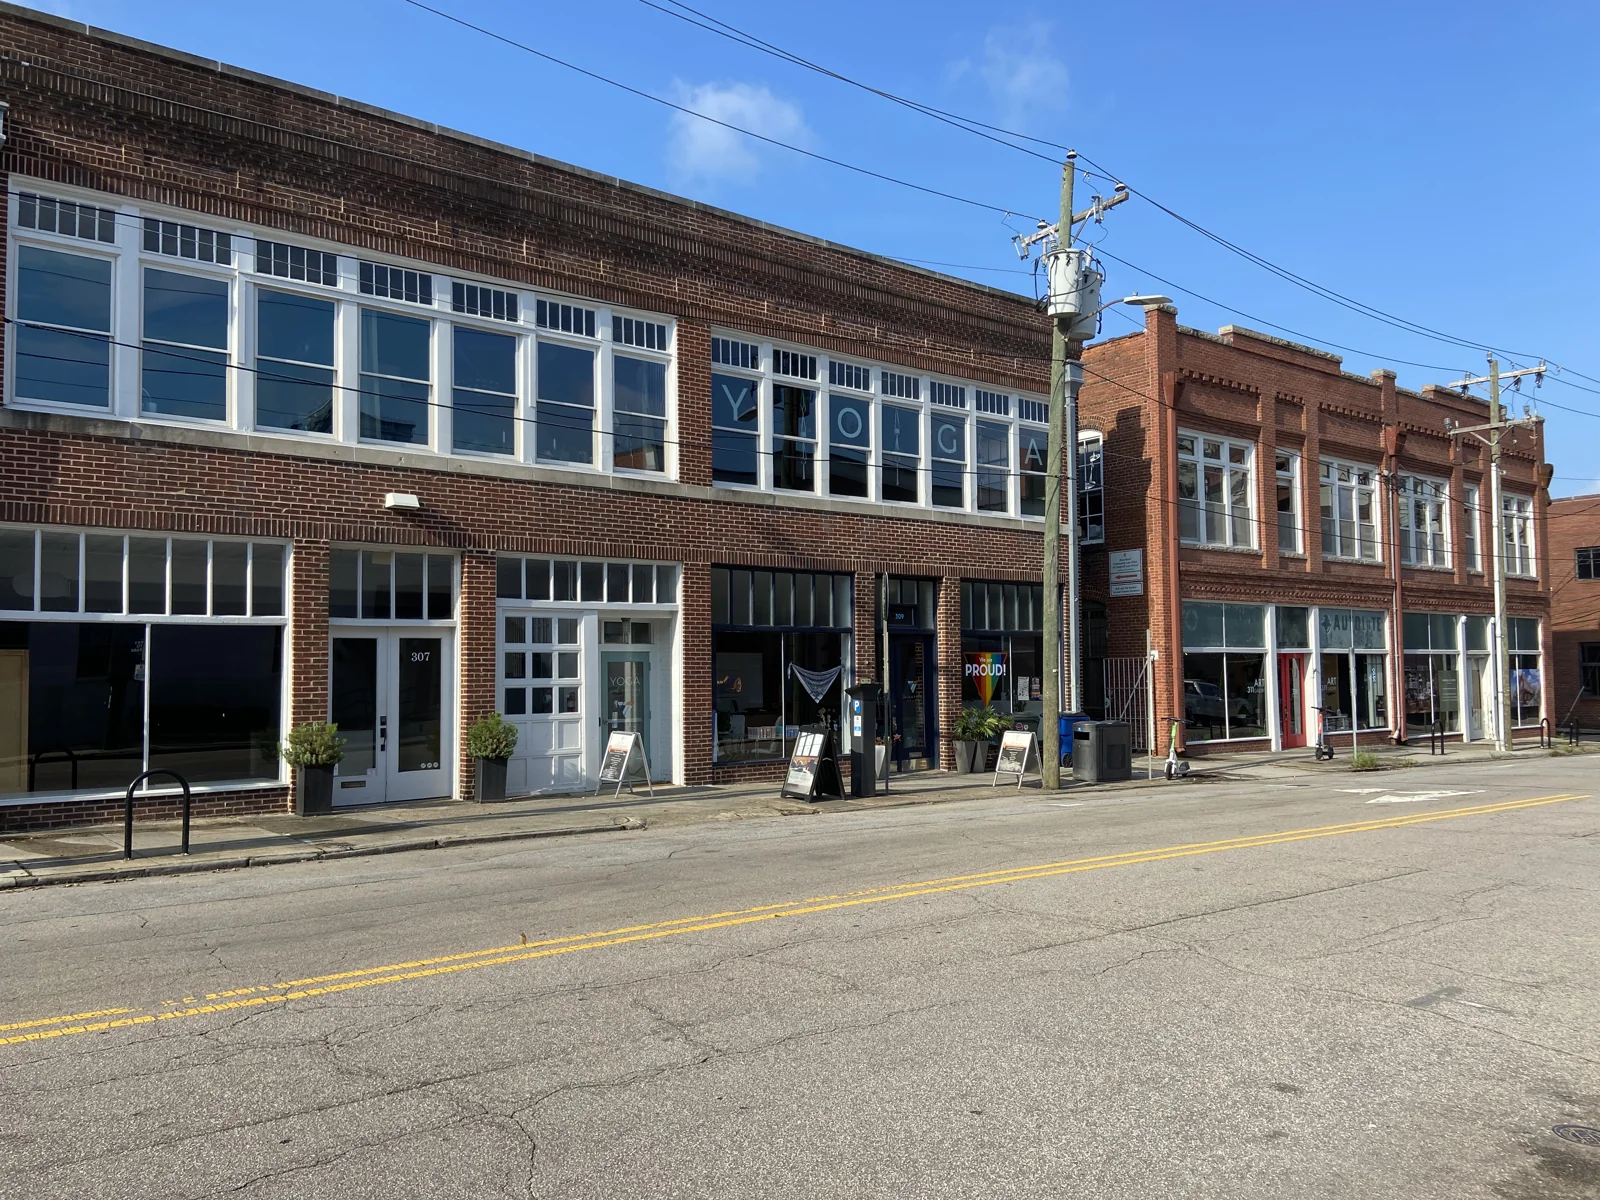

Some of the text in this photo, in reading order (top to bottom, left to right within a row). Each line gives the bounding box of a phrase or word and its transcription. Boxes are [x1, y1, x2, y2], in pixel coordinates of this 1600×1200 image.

[411, 652, 430, 662] 307
[965, 663, 1007, 677] PROUD!
[609, 676, 641, 686] YOGA
[854, 700, 860, 711] P
